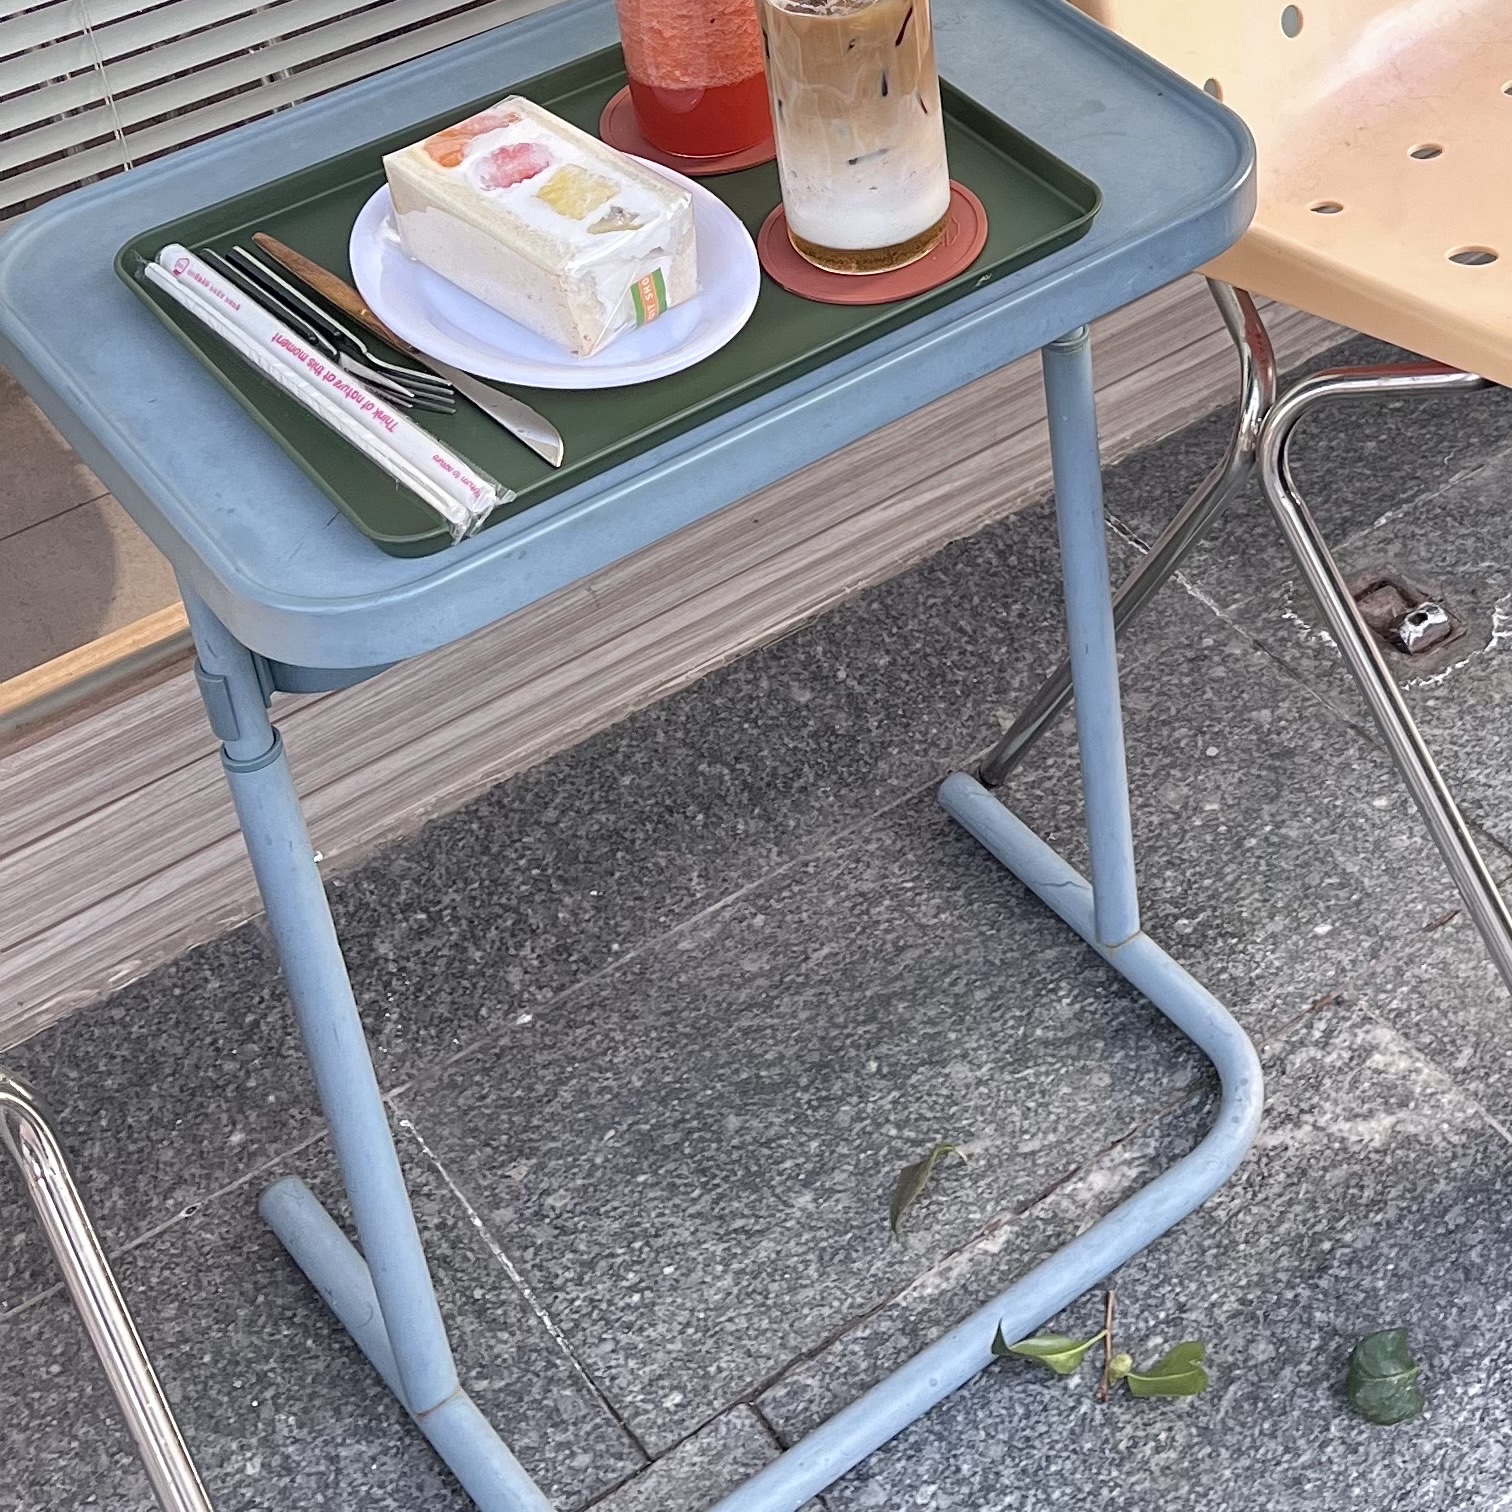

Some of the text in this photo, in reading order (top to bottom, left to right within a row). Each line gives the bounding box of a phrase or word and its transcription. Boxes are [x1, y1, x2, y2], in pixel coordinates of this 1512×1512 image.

[271, 332, 310, 365] moment
[304, 356, 327, 378] this
[320, 370, 338, 386] at
[331, 377, 366, 408] nature
[369, 405, 398, 434] Think
